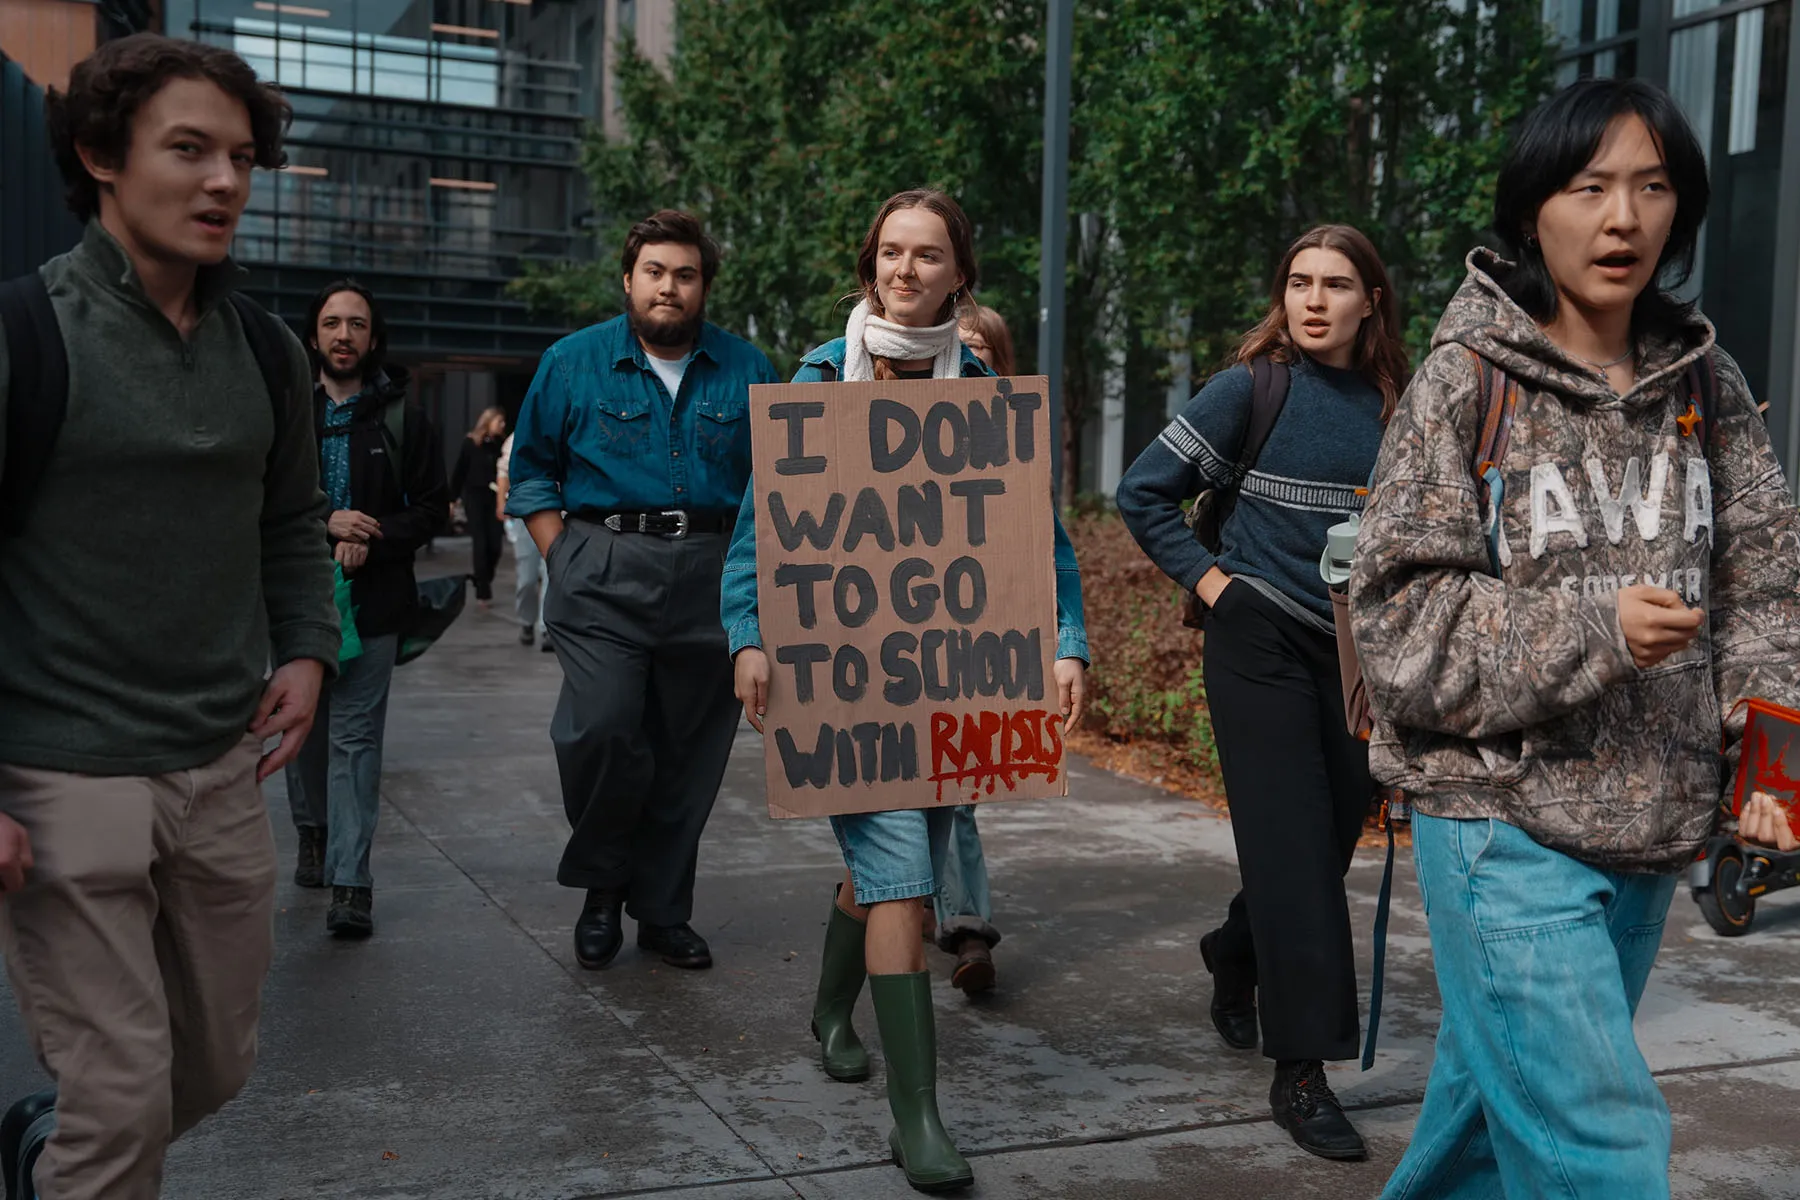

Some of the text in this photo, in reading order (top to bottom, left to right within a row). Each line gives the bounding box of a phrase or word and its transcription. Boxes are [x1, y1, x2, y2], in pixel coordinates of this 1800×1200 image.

[768, 378, 1042, 475] I DON'T
[767, 479, 1006, 553] WANT
[774, 555, 987, 630] TO GO
[776, 627, 1045, 707] TO SCHOOL
[774, 709, 1063, 790] WITH RAPISTS
